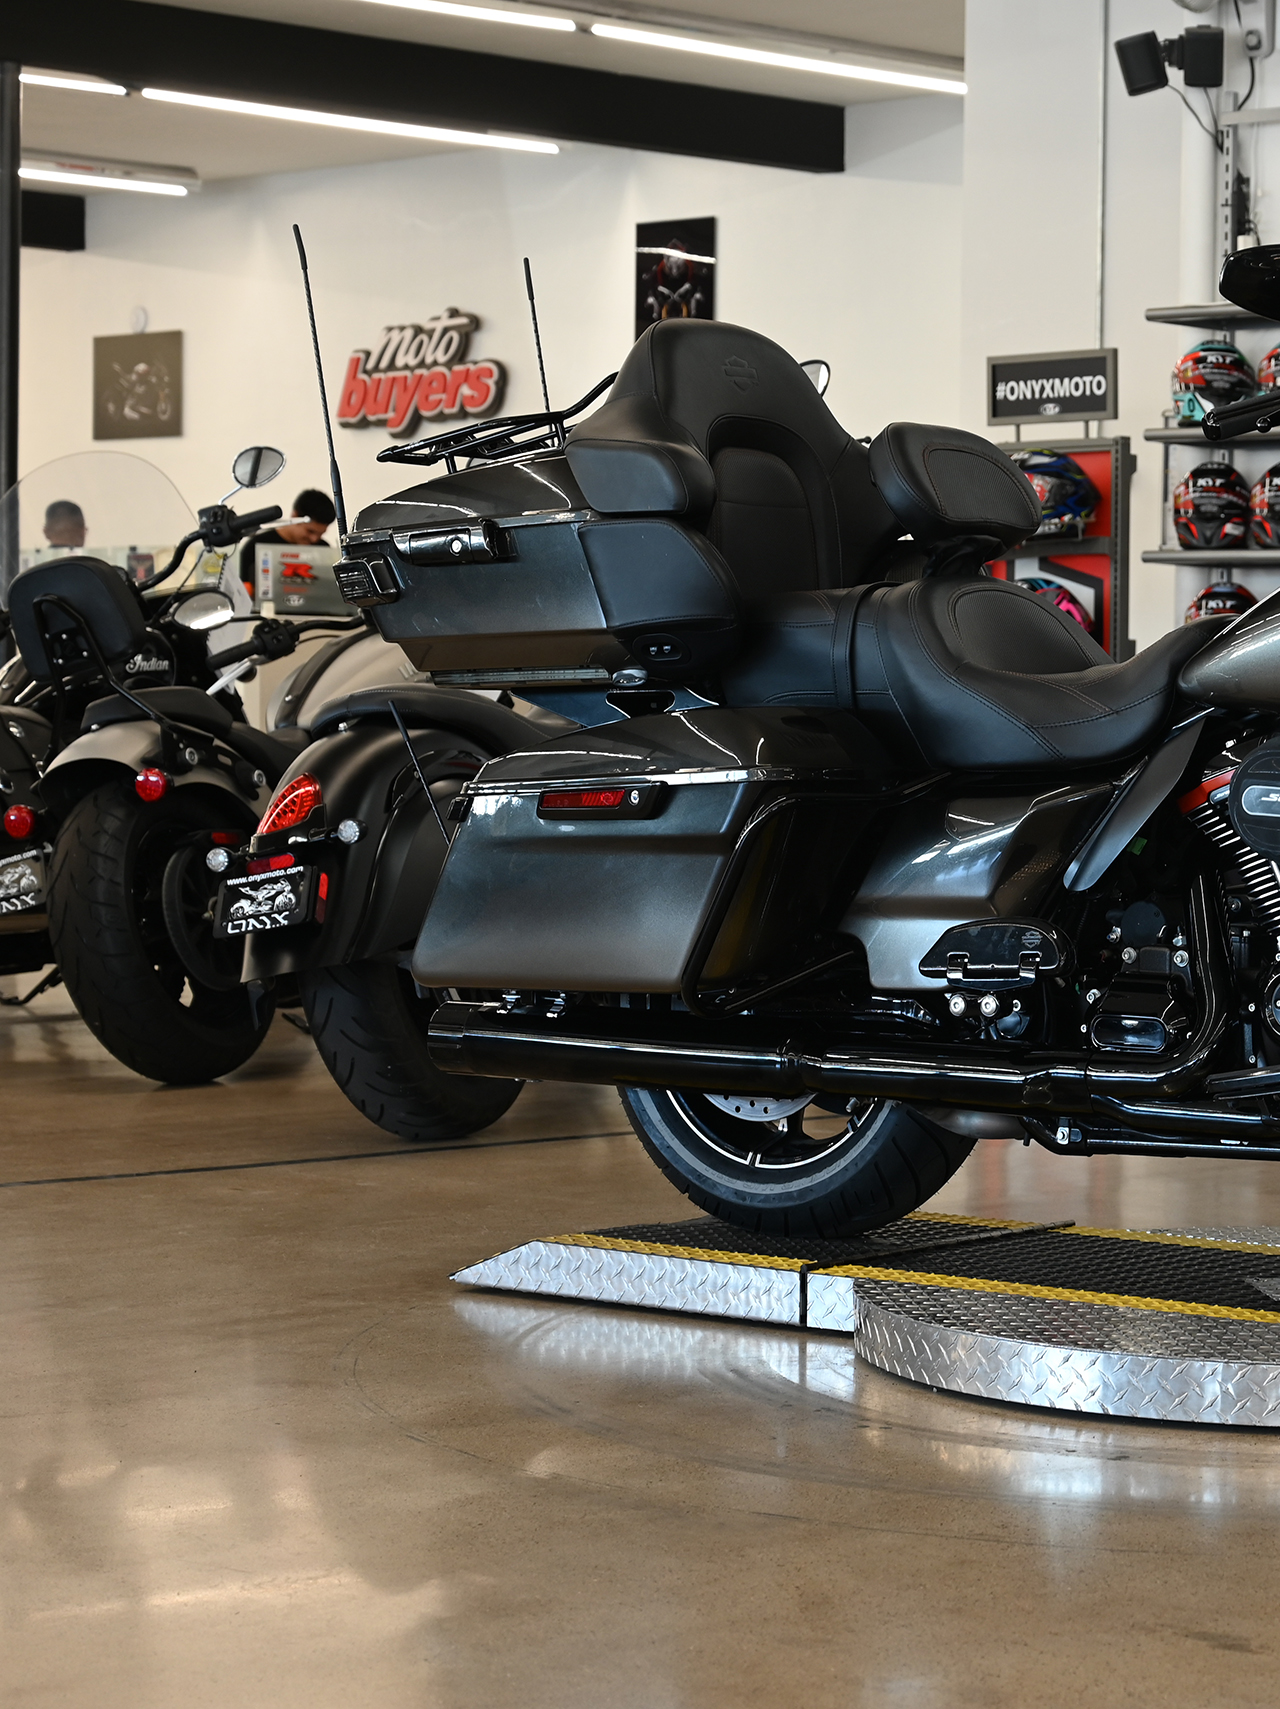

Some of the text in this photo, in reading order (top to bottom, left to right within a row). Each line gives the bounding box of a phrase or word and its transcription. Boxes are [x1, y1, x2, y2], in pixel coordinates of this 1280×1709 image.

[337, 353, 497, 429] buyers
[996, 374, 1107, 402] #ONYXMOTO
[125, 653, 169, 674] Indian
